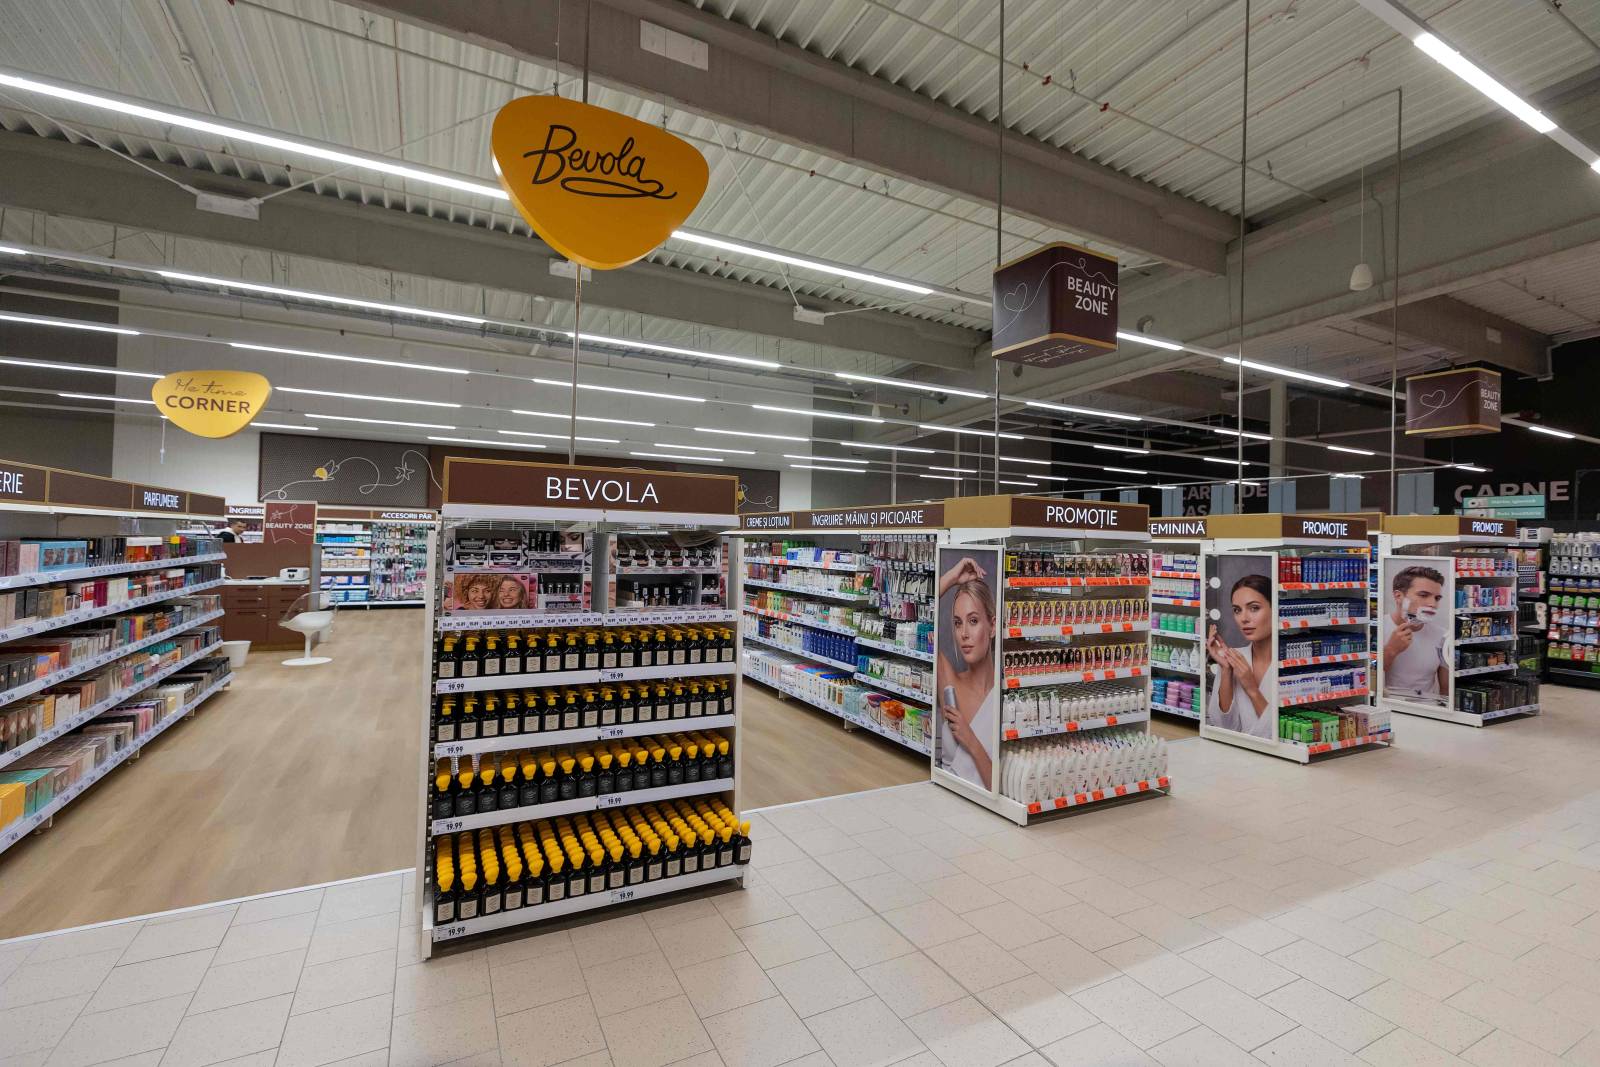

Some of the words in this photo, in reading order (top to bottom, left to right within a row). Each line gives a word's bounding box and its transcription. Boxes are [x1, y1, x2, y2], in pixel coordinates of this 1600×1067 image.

[523, 125, 677, 199] Bevola
[1067, 276, 1116, 301] BEAUTY
[1075, 294, 1109, 316] ZONE
[1480, 388, 1500, 400] BEAUTY
[165, 395, 250, 414] CORNER
[1483, 399, 1499, 411] ZONE
[546, 476, 659, 504] BEVOLA
[143, 491, 179, 509] PARFUMERIE
[746, 516, 763, 528] CREME
[811, 513, 843, 526] ÎNGRUIRE
[845, 511, 869, 525] MÂINI
[880, 510, 924, 525] PICIOARE
[1046, 505, 1119, 529] PROMOȚIE
[265, 522, 293, 530] BEAUTY
[1148, 520, 1206, 535] EMININĂ
[1302, 521, 1348, 538] PROMOȚIE
[1471, 521, 1504, 536] PROMOȚIE
[448, 683, 465, 691] 19.99
[447, 746, 463, 754] 19.99
[446, 821, 463, 831] 19.99
[448, 926, 466, 936] 19.99
